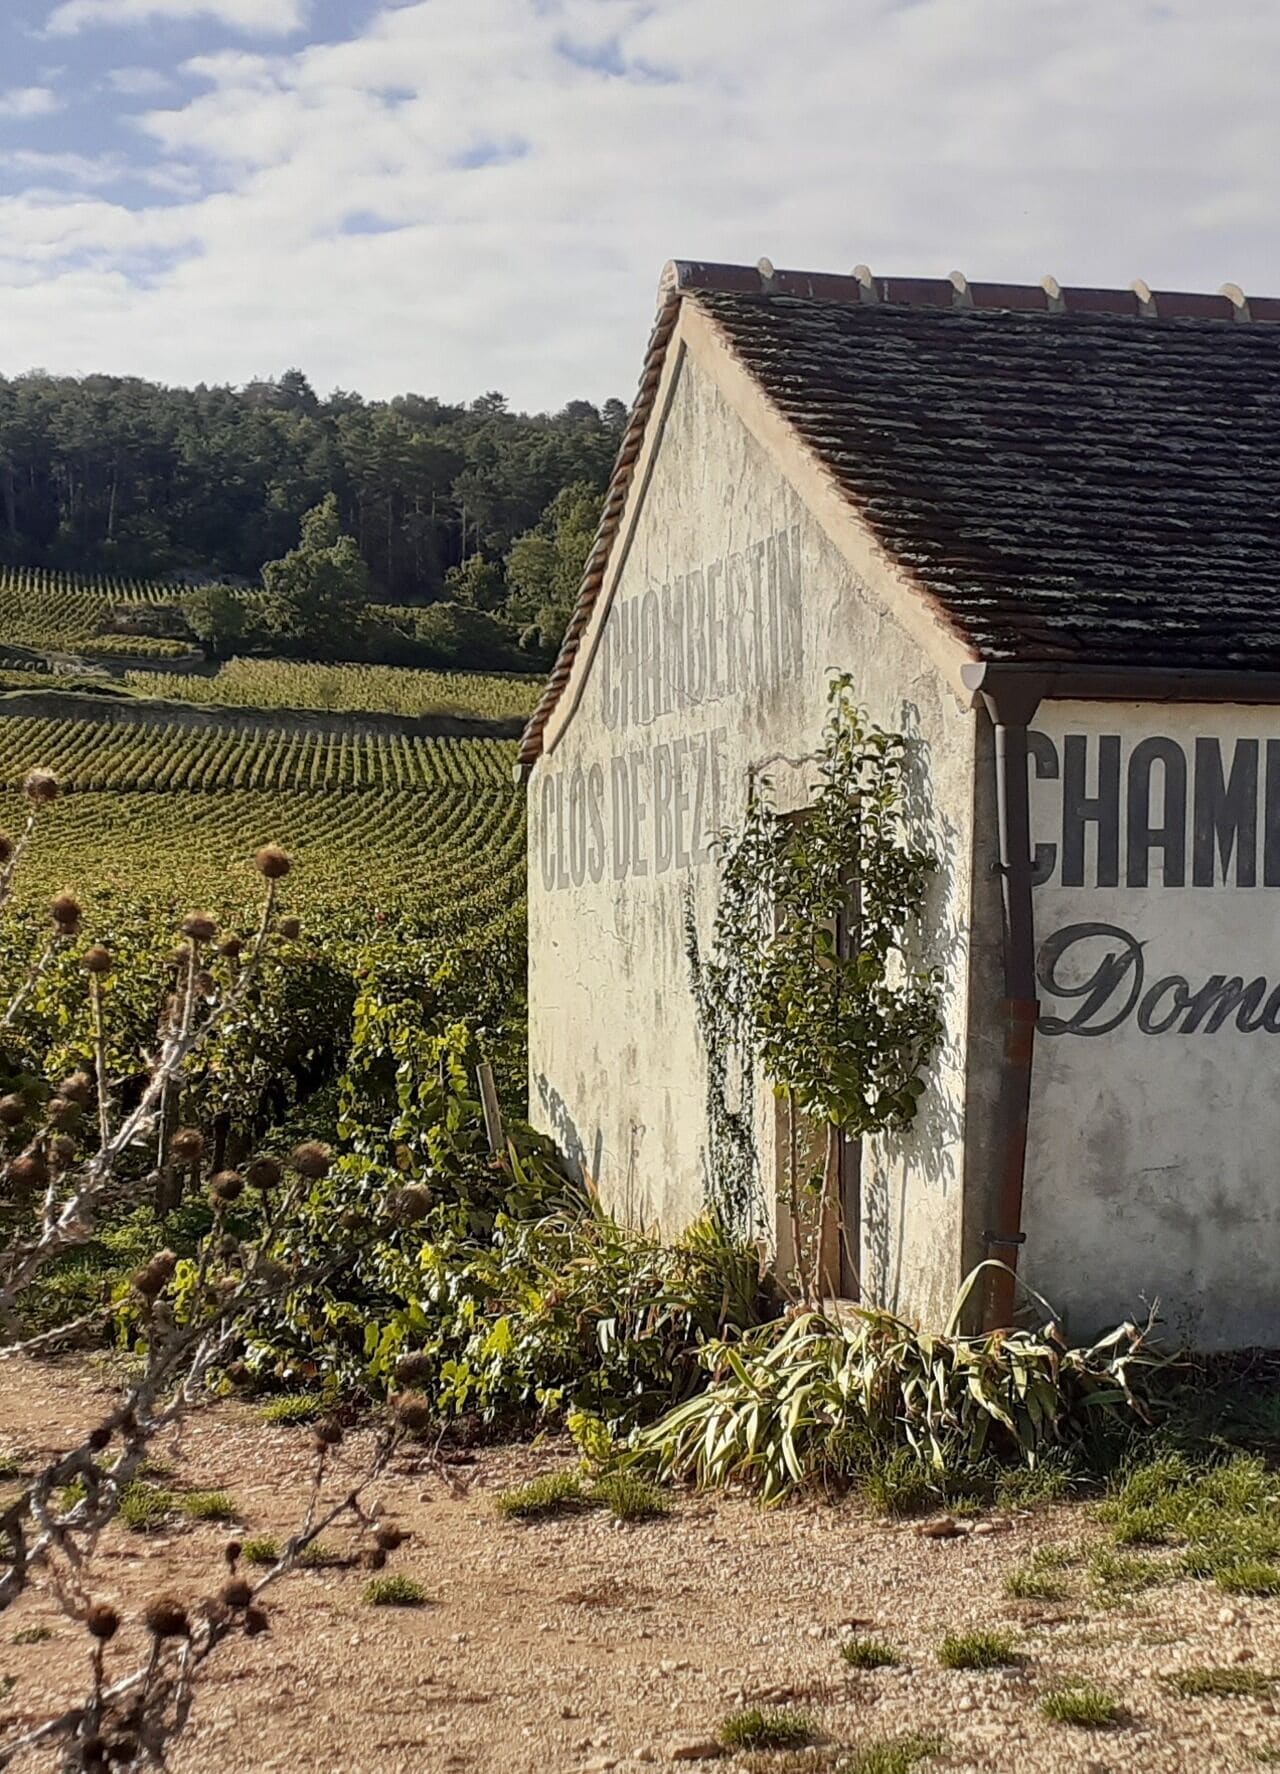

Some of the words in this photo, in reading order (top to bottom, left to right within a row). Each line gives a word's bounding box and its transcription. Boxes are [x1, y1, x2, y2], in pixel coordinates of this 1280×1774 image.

[601, 525, 803, 732] CHAMBERTIN
[541, 764, 605, 893] CLOS
[611, 751, 648, 881] DE
